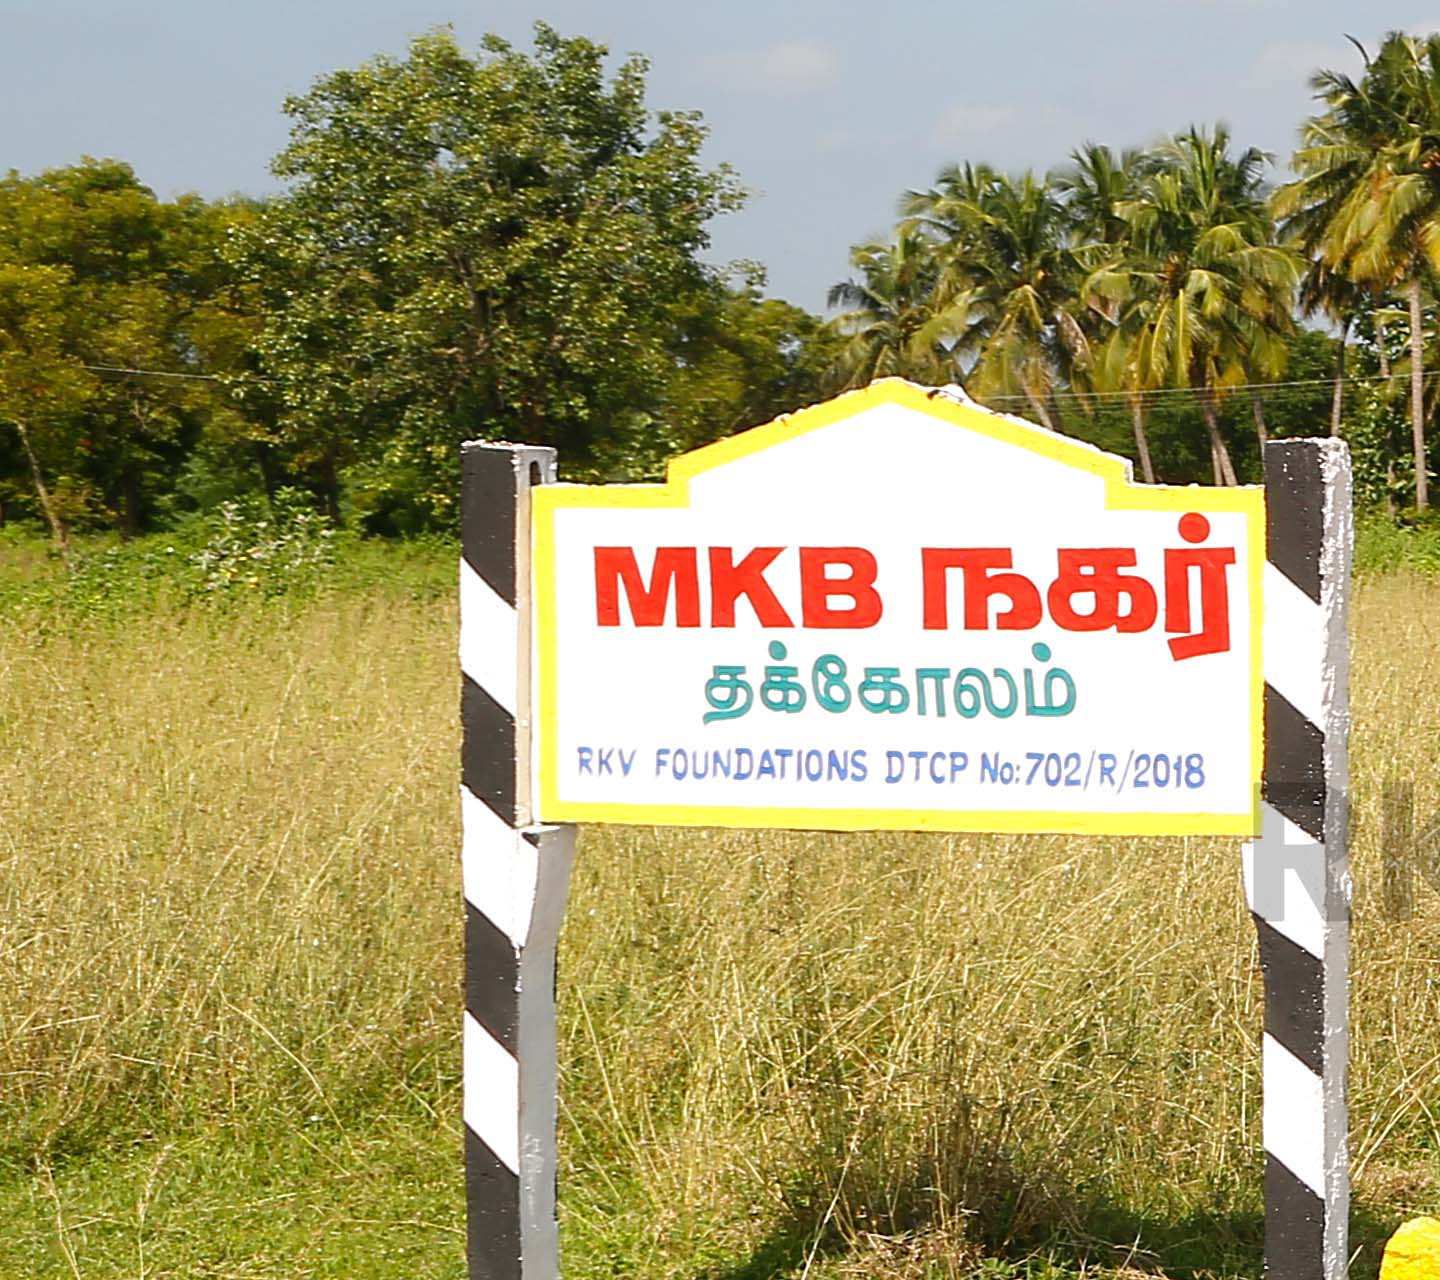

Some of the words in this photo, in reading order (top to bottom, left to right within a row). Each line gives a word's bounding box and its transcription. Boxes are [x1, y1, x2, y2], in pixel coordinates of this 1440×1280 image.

[593, 546, 884, 629] MKB
[921, 512, 1237, 662] நகர்
[702, 639, 1077, 725] தக்கோலம்
[577, 746, 637, 777] RKV
[655, 747, 868, 783] FOUNDATIONS
[884, 750, 969, 785] DTCP
